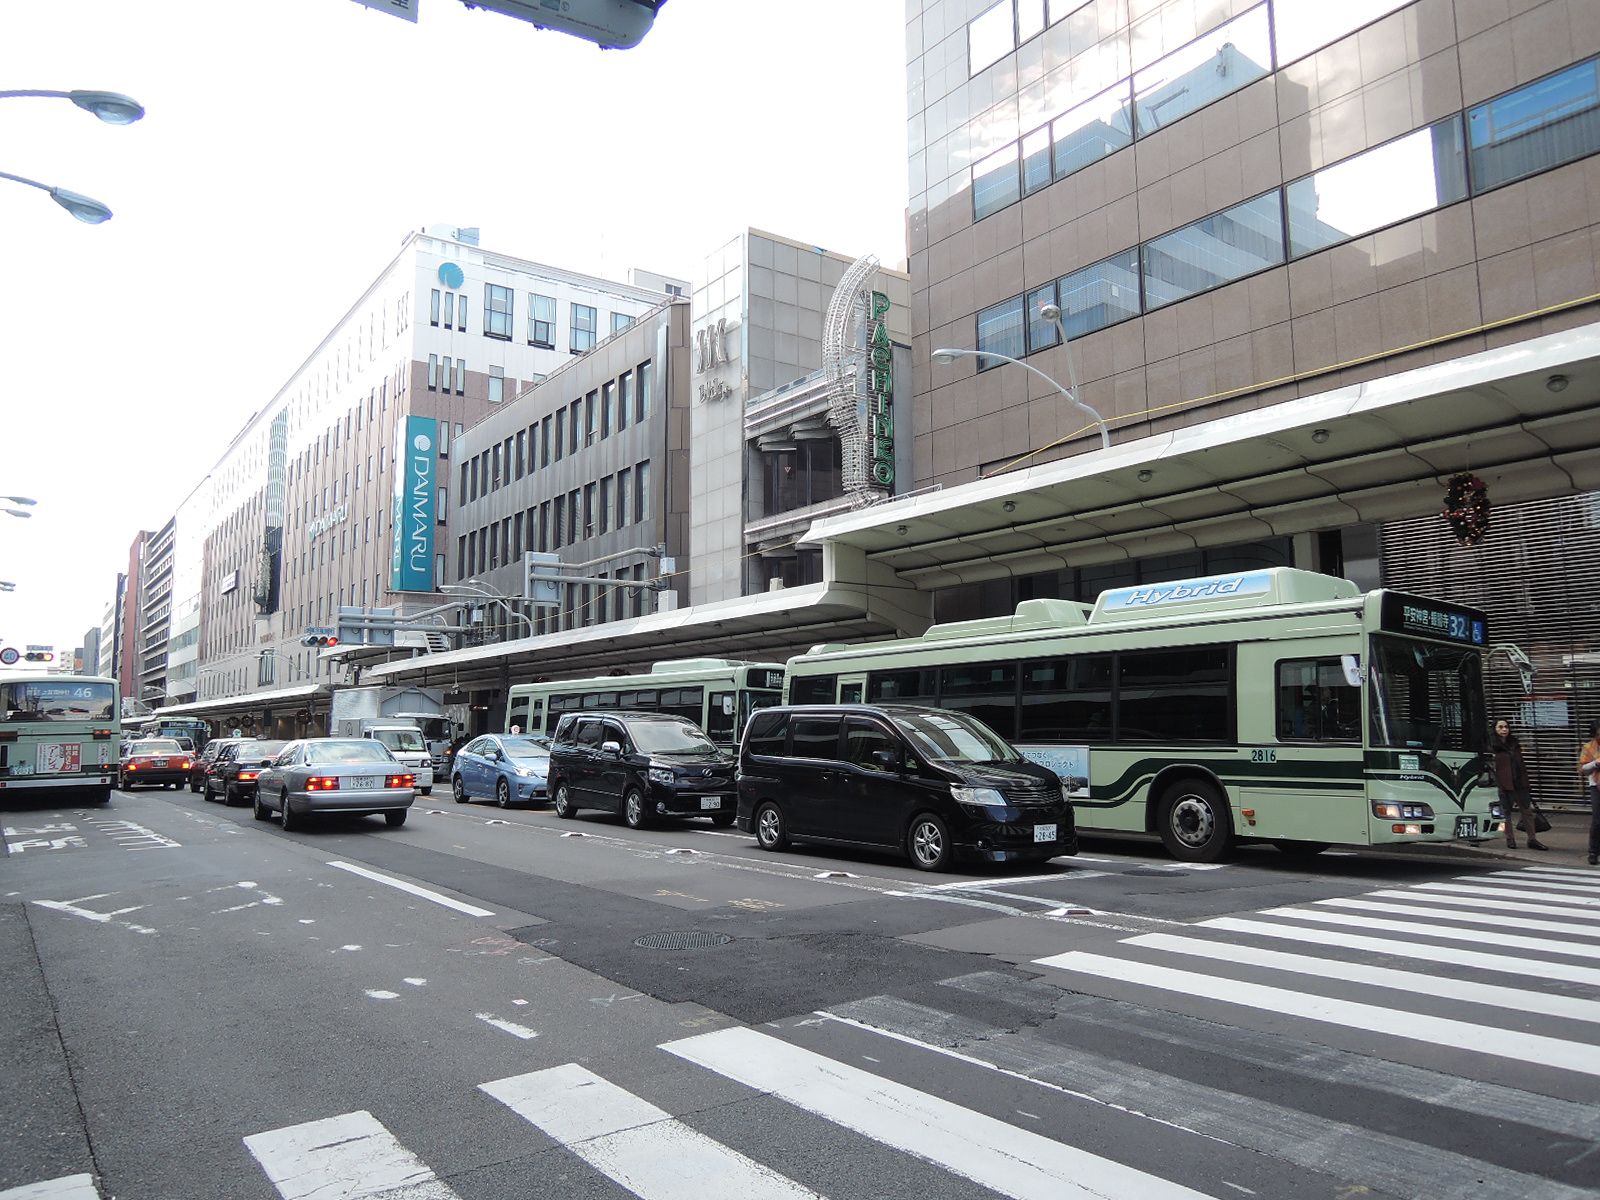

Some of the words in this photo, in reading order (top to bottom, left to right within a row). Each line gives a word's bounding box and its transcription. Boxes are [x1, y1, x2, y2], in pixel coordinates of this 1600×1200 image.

[870, 289, 894, 485] PACHINKO
[411, 455, 431, 572] DAIMARU
[1125, 577, 1245, 605] Hybrid
[1450, 615, 1466, 638] 32
[73, 687, 92, 698] 46
[1251, 749, 1276, 762] 2816
